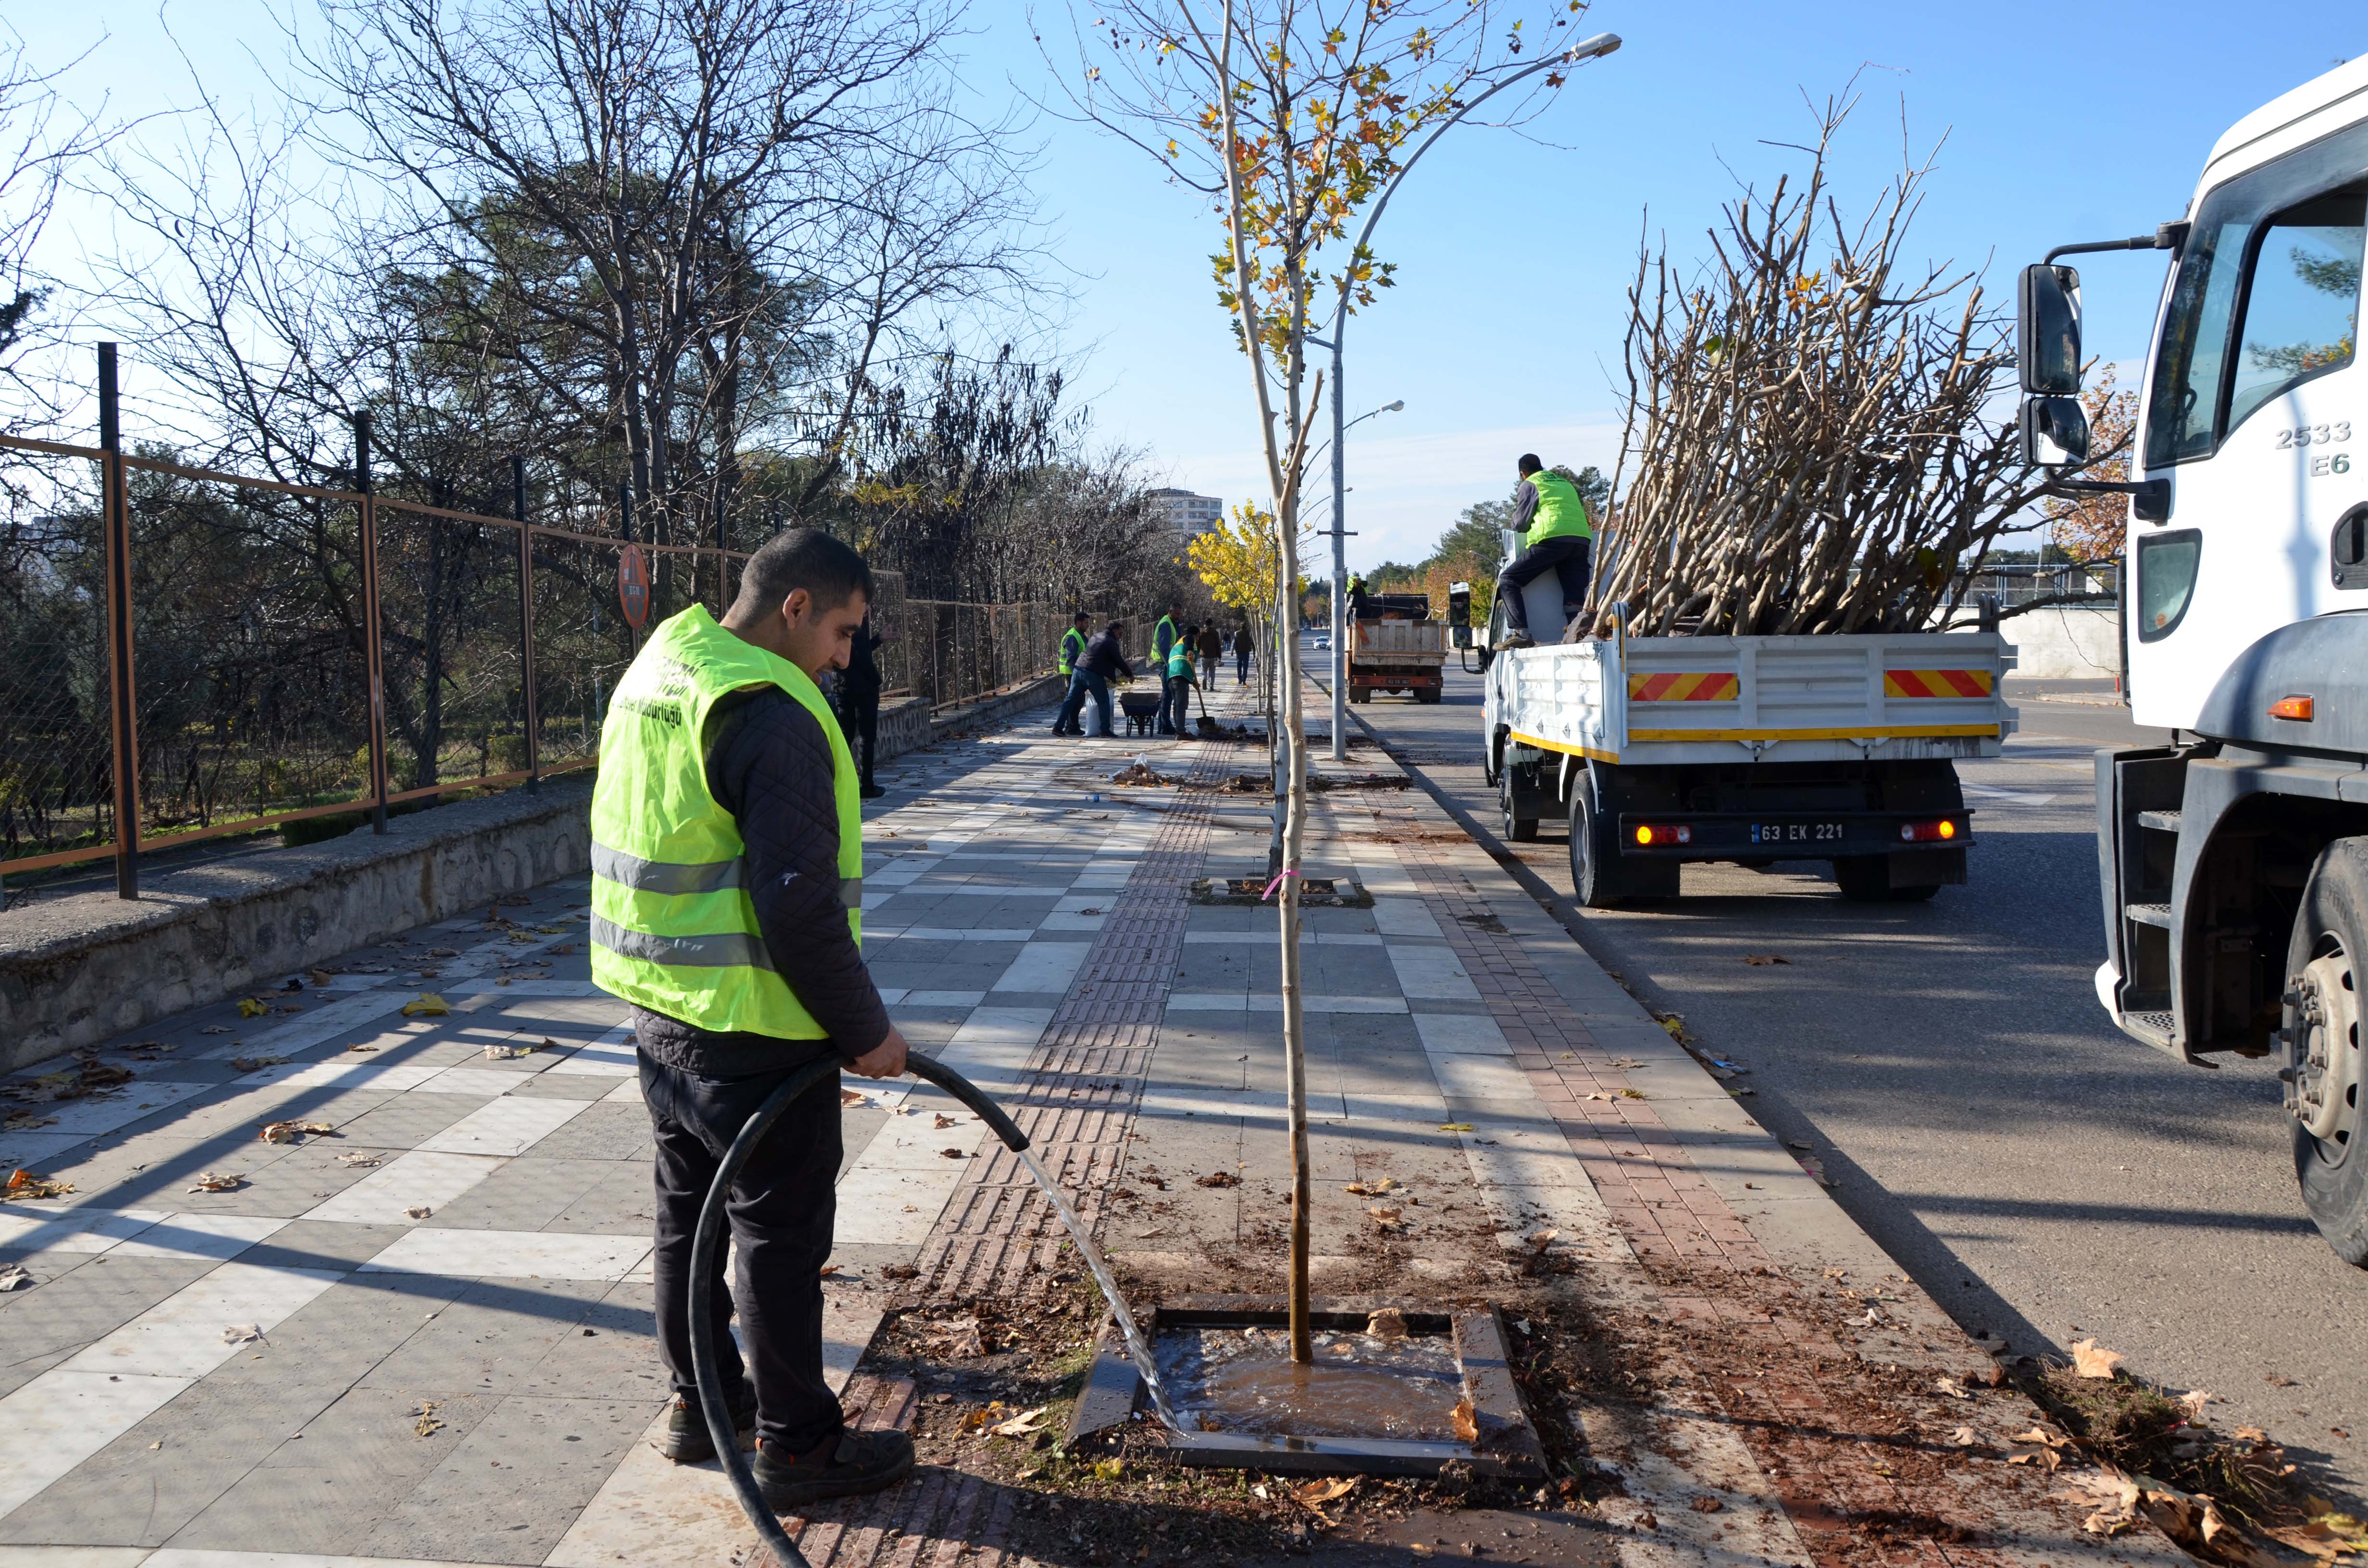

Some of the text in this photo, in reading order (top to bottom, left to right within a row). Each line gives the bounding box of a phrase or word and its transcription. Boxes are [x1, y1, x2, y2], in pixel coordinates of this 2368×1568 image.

[2275, 420, 2352, 450] 2533
[2310, 453, 2350, 477] E6
[1762, 823, 1843, 840] 63 EK 221
